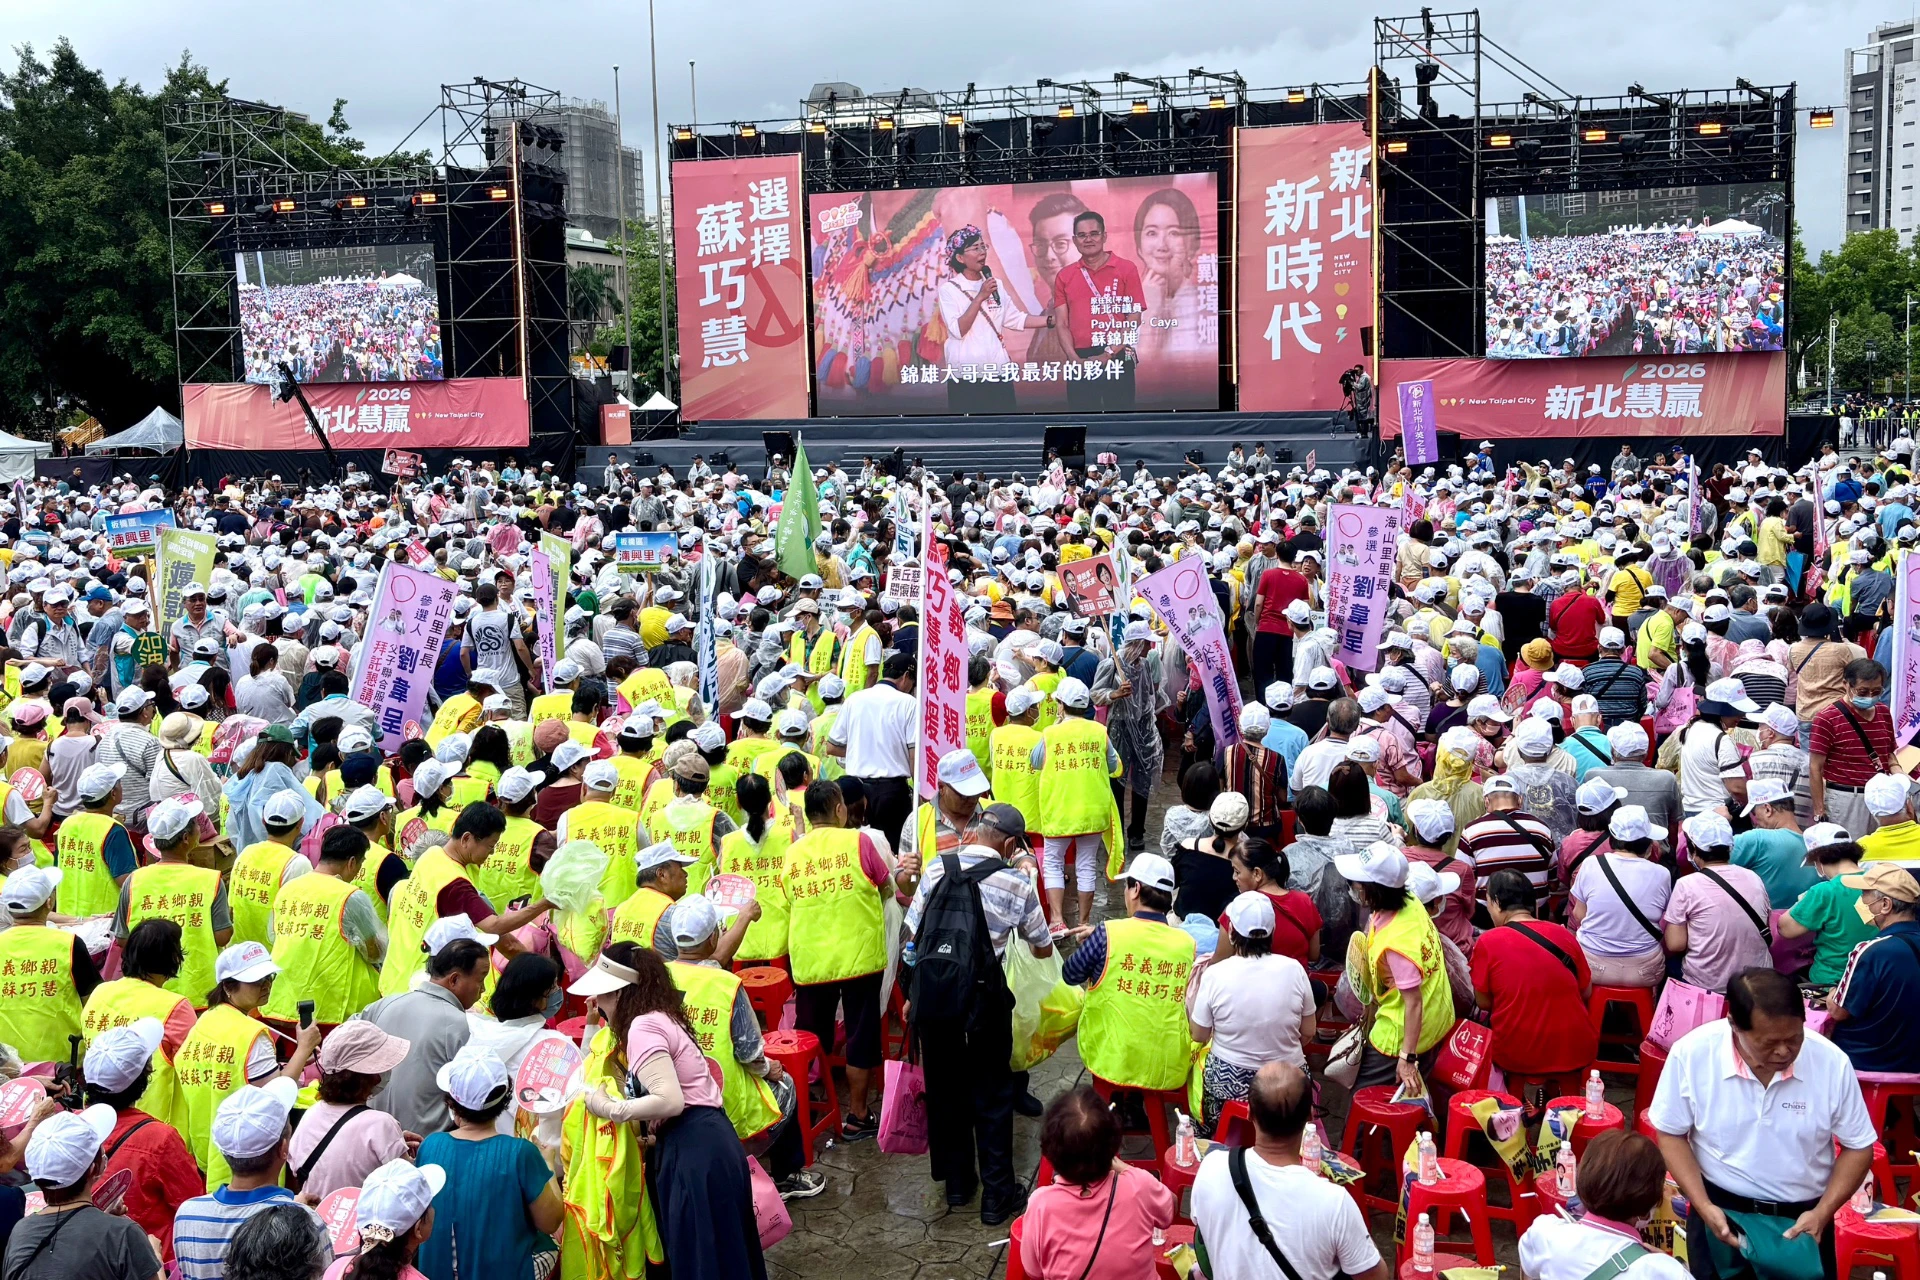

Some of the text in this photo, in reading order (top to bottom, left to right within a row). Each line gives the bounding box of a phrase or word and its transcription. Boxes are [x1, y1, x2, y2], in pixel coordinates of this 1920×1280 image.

[1329, 146, 1371, 243] 新北
[748, 176, 790, 268] 選擇
[1263, 175, 1324, 361] 新時代
[1334, 253, 1351, 261] NEW
[1334, 260, 1359, 268] TAIPEI
[1334, 268, 1352, 276] CITY
[696, 201, 750, 368] 蘇巧慧
[1090, 303, 1142, 315] 新北市議員
[1091, 317, 1178, 332] Paylang Caya
[1091, 331, 1139, 347] 蘇錦雄
[900, 358, 1125, 385] 錦雄大哥是我最好的夥伴
[1641, 363, 1706, 379] 2026
[368, 387, 411, 401] 2026
[1488, 397, 1516, 406] Taipei
[1518, 396, 1536, 406] City
[1543, 382, 1704, 420] 新北慧贏
[304, 403, 411, 435] 新北慧贏
[449, 411, 470, 419] Taipei
[470, 411, 485, 419] City
[1412, 400, 1427, 463] 新北市小英之友會
[619, 549, 655, 562] 湳興里
[1364, 526, 1379, 566] 參選人
[1375, 515, 1397, 592] 海山里里長
[410, 594, 433, 637] 參選人
[1343, 574, 1375, 654] 劉韋呈
[419, 588, 454, 669] 海山里里長
[138, 632, 163, 665] 加油
[381, 644, 420, 736] 劉韋呈
[996, 743, 1033, 758] 嘉義鄉
[1053, 741, 1100, 755] 嘉義鄉親
[1055, 757, 1101, 771] 挺蘇巧慧
[575, 826, 630, 841] 嘉義鄉親
[61, 854, 96, 873] 蘇巧慧
[729, 856, 784, 874] 嘉義鄉親
[788, 852, 852, 880] 嘉義鄉親
[233, 881, 271, 905] 蘇巧慧
[792, 872, 854, 900] 挺蘇巧慧
[141, 892, 204, 912] 嘉義鄉親
[279, 899, 330, 920] 嘉義鄉親
[1120, 953, 1188, 979] 嘉義鄉親
[1117, 975, 1185, 1003] 挺蘇巧慧
[84, 1010, 141, 1032] 嘉義鄉
[182, 1041, 235, 1065] 嘉義鄉親
